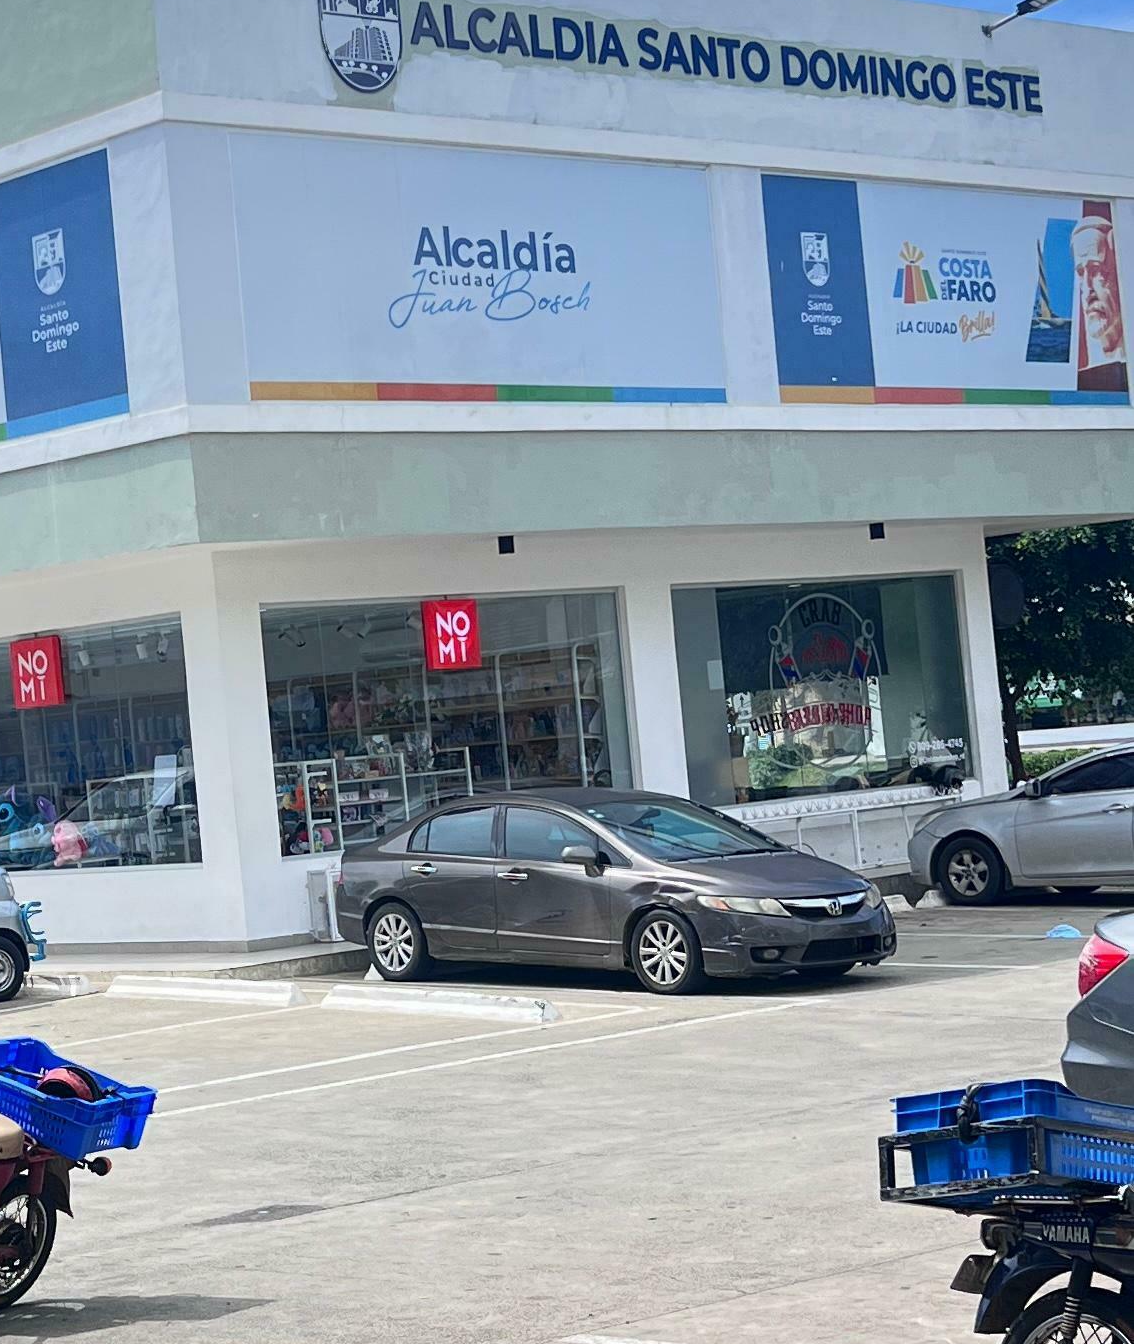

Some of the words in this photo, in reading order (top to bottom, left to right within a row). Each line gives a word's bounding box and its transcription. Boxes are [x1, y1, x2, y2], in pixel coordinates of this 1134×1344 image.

[410, 0, 629, 67] ALCALDIA
[637, 26, 772, 84] SANTO
[782, 45, 958, 103] DOMINGO
[965, 67, 1043, 114] ESTE
[413, 225, 577, 274] Alcaldía
[429, 270, 495, 288] Ciudad
[939, 257, 992, 279] COSTA
[388, 268, 478, 328] Juan
[484, 268, 591, 321] Bosch
[947, 279, 996, 303] FARO
[807, 300, 834, 312] Santo
[39, 309, 69, 327] Santo
[800, 312, 842, 326] Domingo
[915, 320, 958, 335] CIUDAD
[959, 310, 995, 343] Brilla!
[31, 321, 80, 343] Domingo
[812, 324, 833, 336] Este
[45, 338, 68, 353] Este
[435, 610, 471, 638] NO
[17, 649, 48, 678] NO
[1042, 1223, 1091, 1244] YAMAHA
